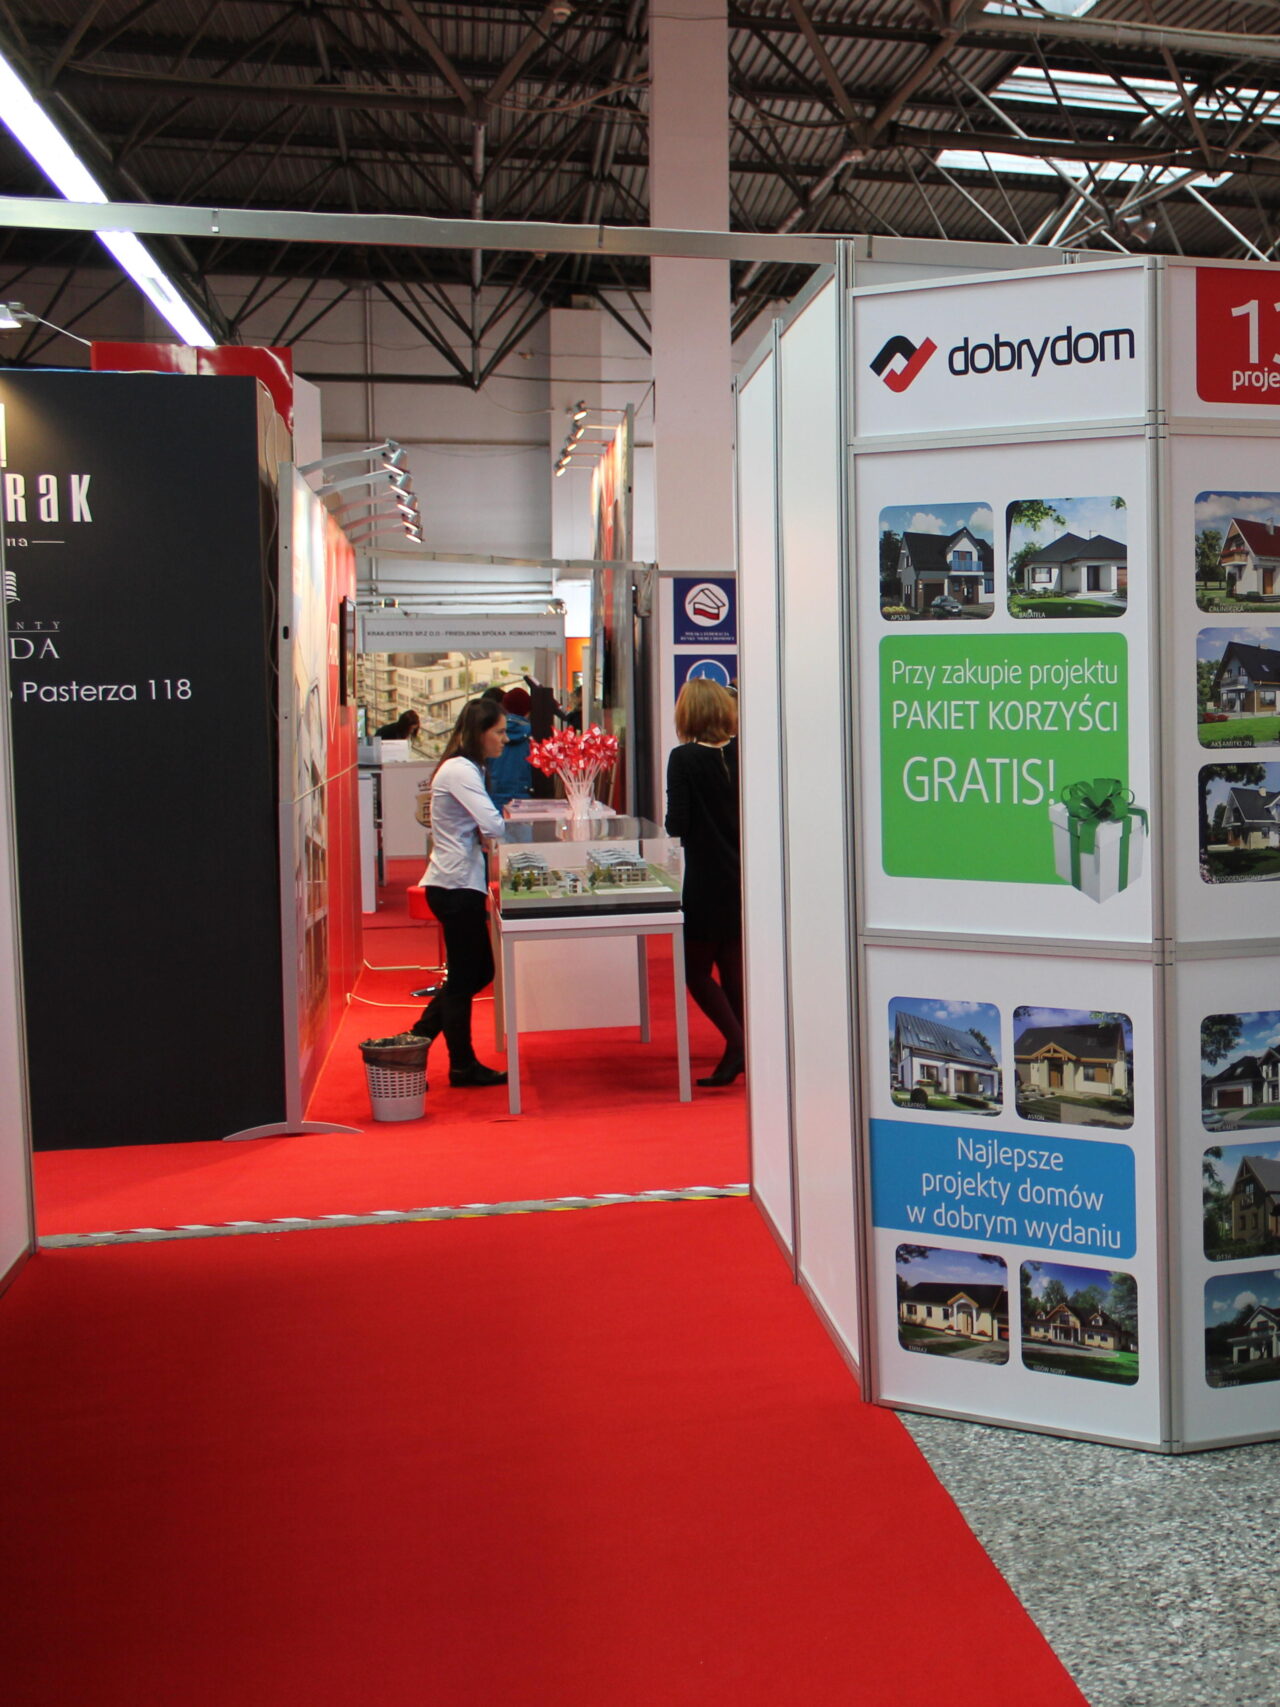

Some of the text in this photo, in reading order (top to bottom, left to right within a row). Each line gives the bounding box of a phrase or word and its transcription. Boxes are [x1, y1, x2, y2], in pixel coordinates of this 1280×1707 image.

[948, 326, 1136, 378] dobrydom
[22, 679, 192, 702] Pasterza 118
[892, 657, 1118, 691] Przy zakupie projektu
[892, 694, 1118, 731] PAKIET KORZYŚCI
[902, 756, 1054, 805] GRATIS!
[956, 1137, 1064, 1174] Najlepsze
[921, 1171, 1104, 1212] projekty domów
[906, 1203, 1121, 1250] w dobrym wydaniu
